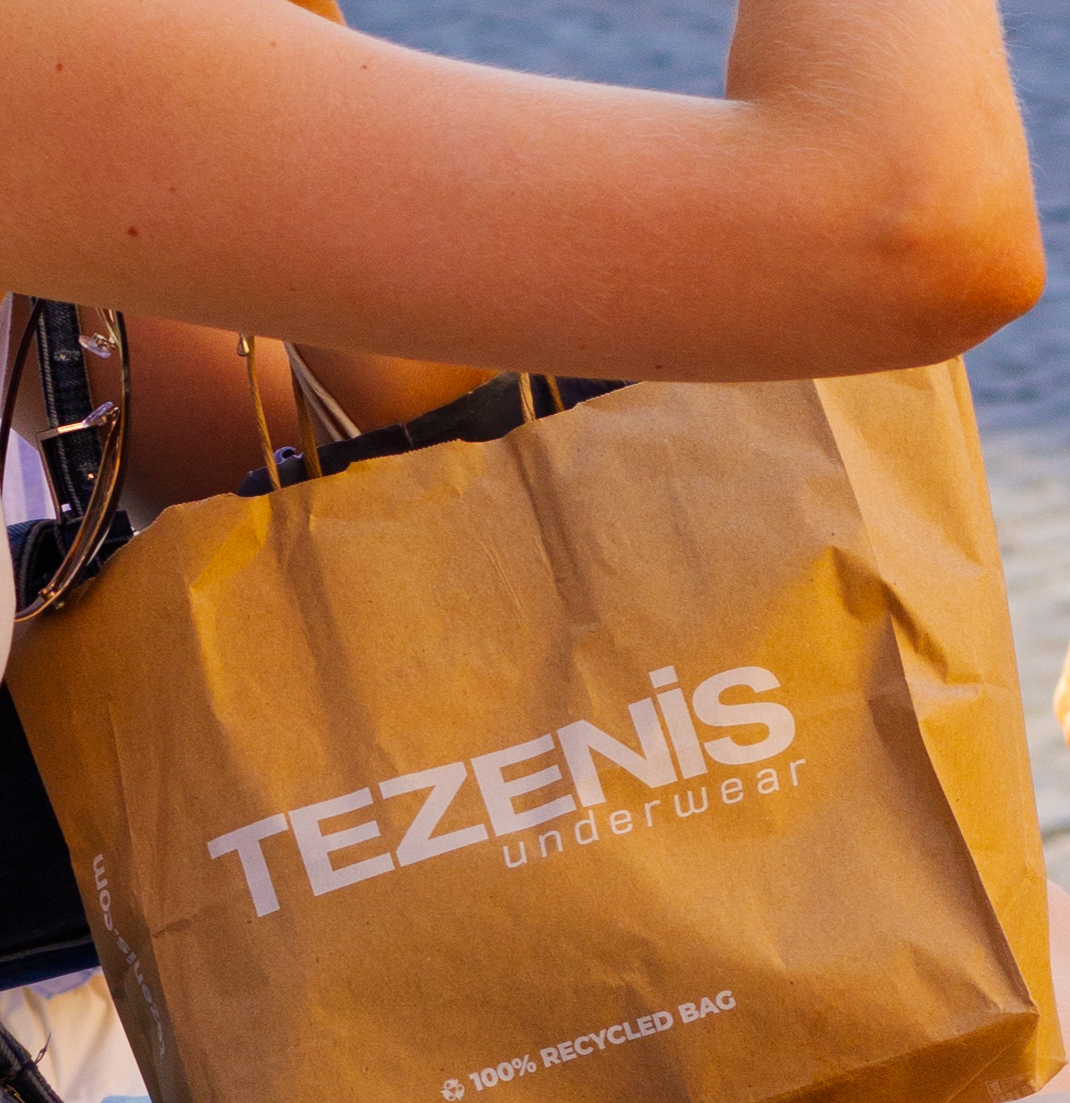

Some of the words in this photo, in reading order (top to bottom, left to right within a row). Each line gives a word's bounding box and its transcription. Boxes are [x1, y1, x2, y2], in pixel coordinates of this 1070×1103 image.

[502, 758, 806, 869] underwear
[468, 1054, 537, 1091] 100%
[540, 1010, 674, 1067] RECYCLED
[678, 990, 737, 1023] BAG
